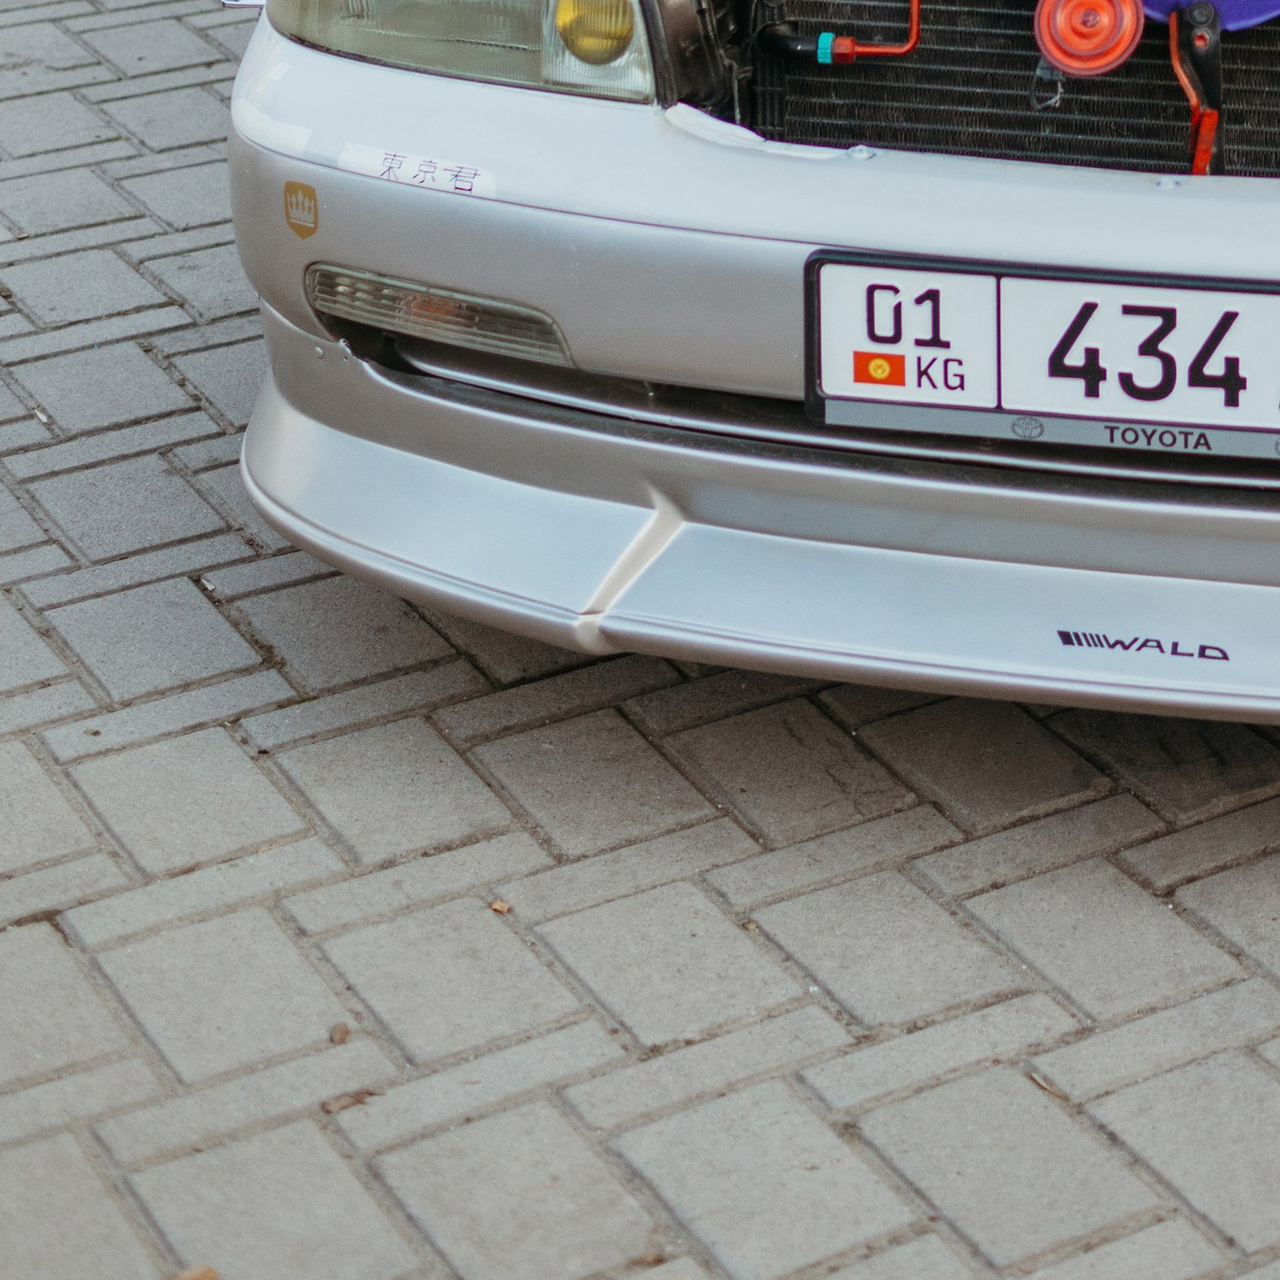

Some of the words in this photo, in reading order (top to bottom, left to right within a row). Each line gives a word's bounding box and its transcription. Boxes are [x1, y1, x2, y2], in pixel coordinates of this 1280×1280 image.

[865, 283, 951, 350] 01
[1047, 301, 1248, 409] 434
[916, 356, 966, 392] KG
[1103, 424, 1213, 452] TOYOTA
[1100, 634, 1230, 662] WALD
